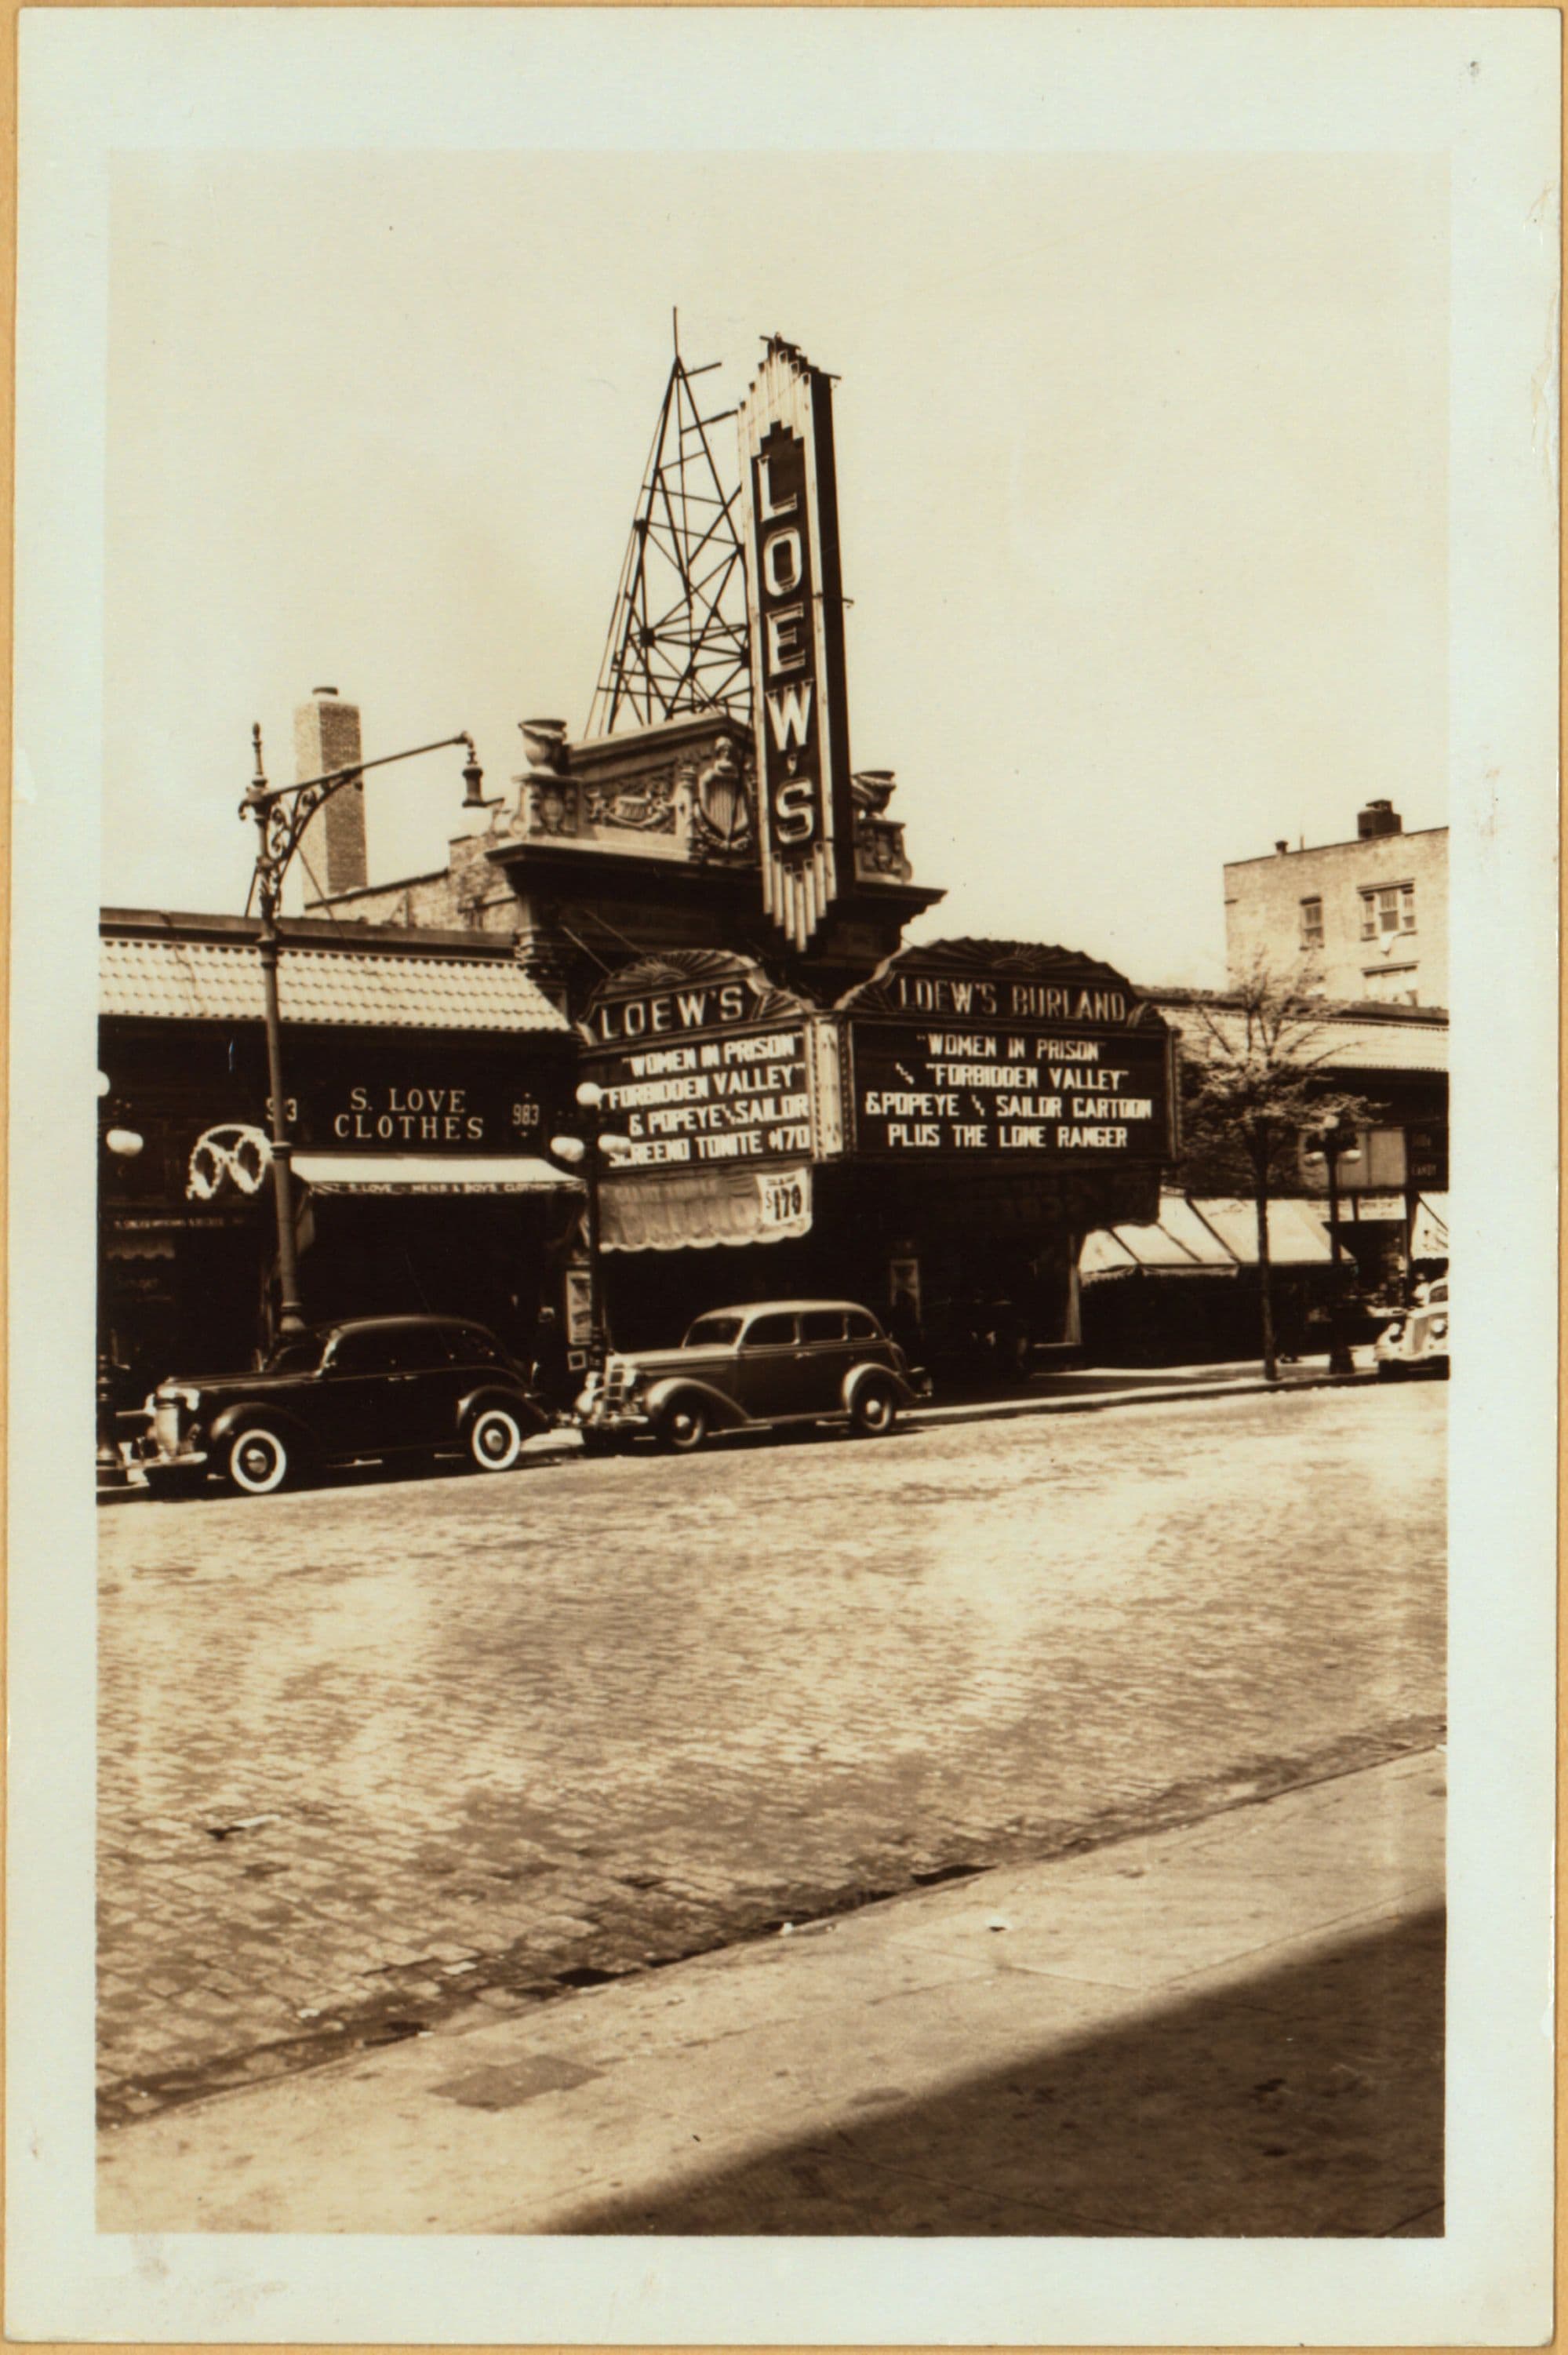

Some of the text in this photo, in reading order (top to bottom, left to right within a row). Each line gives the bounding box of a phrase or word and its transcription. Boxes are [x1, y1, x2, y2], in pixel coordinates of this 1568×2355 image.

[758, 454, 816, 845] LOEW'S
[899, 977, 1127, 1021] LOEW'S BURLAND
[602, 986, 744, 1040] LOEW'S
[700, 1044, 720, 1067] IN
[1008, 1036, 1025, 1058] IN
[266, 1097, 297, 1122] 93
[350, 1088, 467, 1113] S. LOVE
[995, 1095, 1063, 1119] SAILOR
[1072, 1097, 1152, 1120] CARTOON
[512, 1103, 540, 1126] 983
[629, 1112, 644, 1137] &
[648, 1103, 723, 1134] POPEYE
[734, 1094, 809, 1125] SAILOR
[334, 1115, 484, 1141] CLOTHES
[887, 1123, 1128, 1148] PLUS THE LONE RANGER
